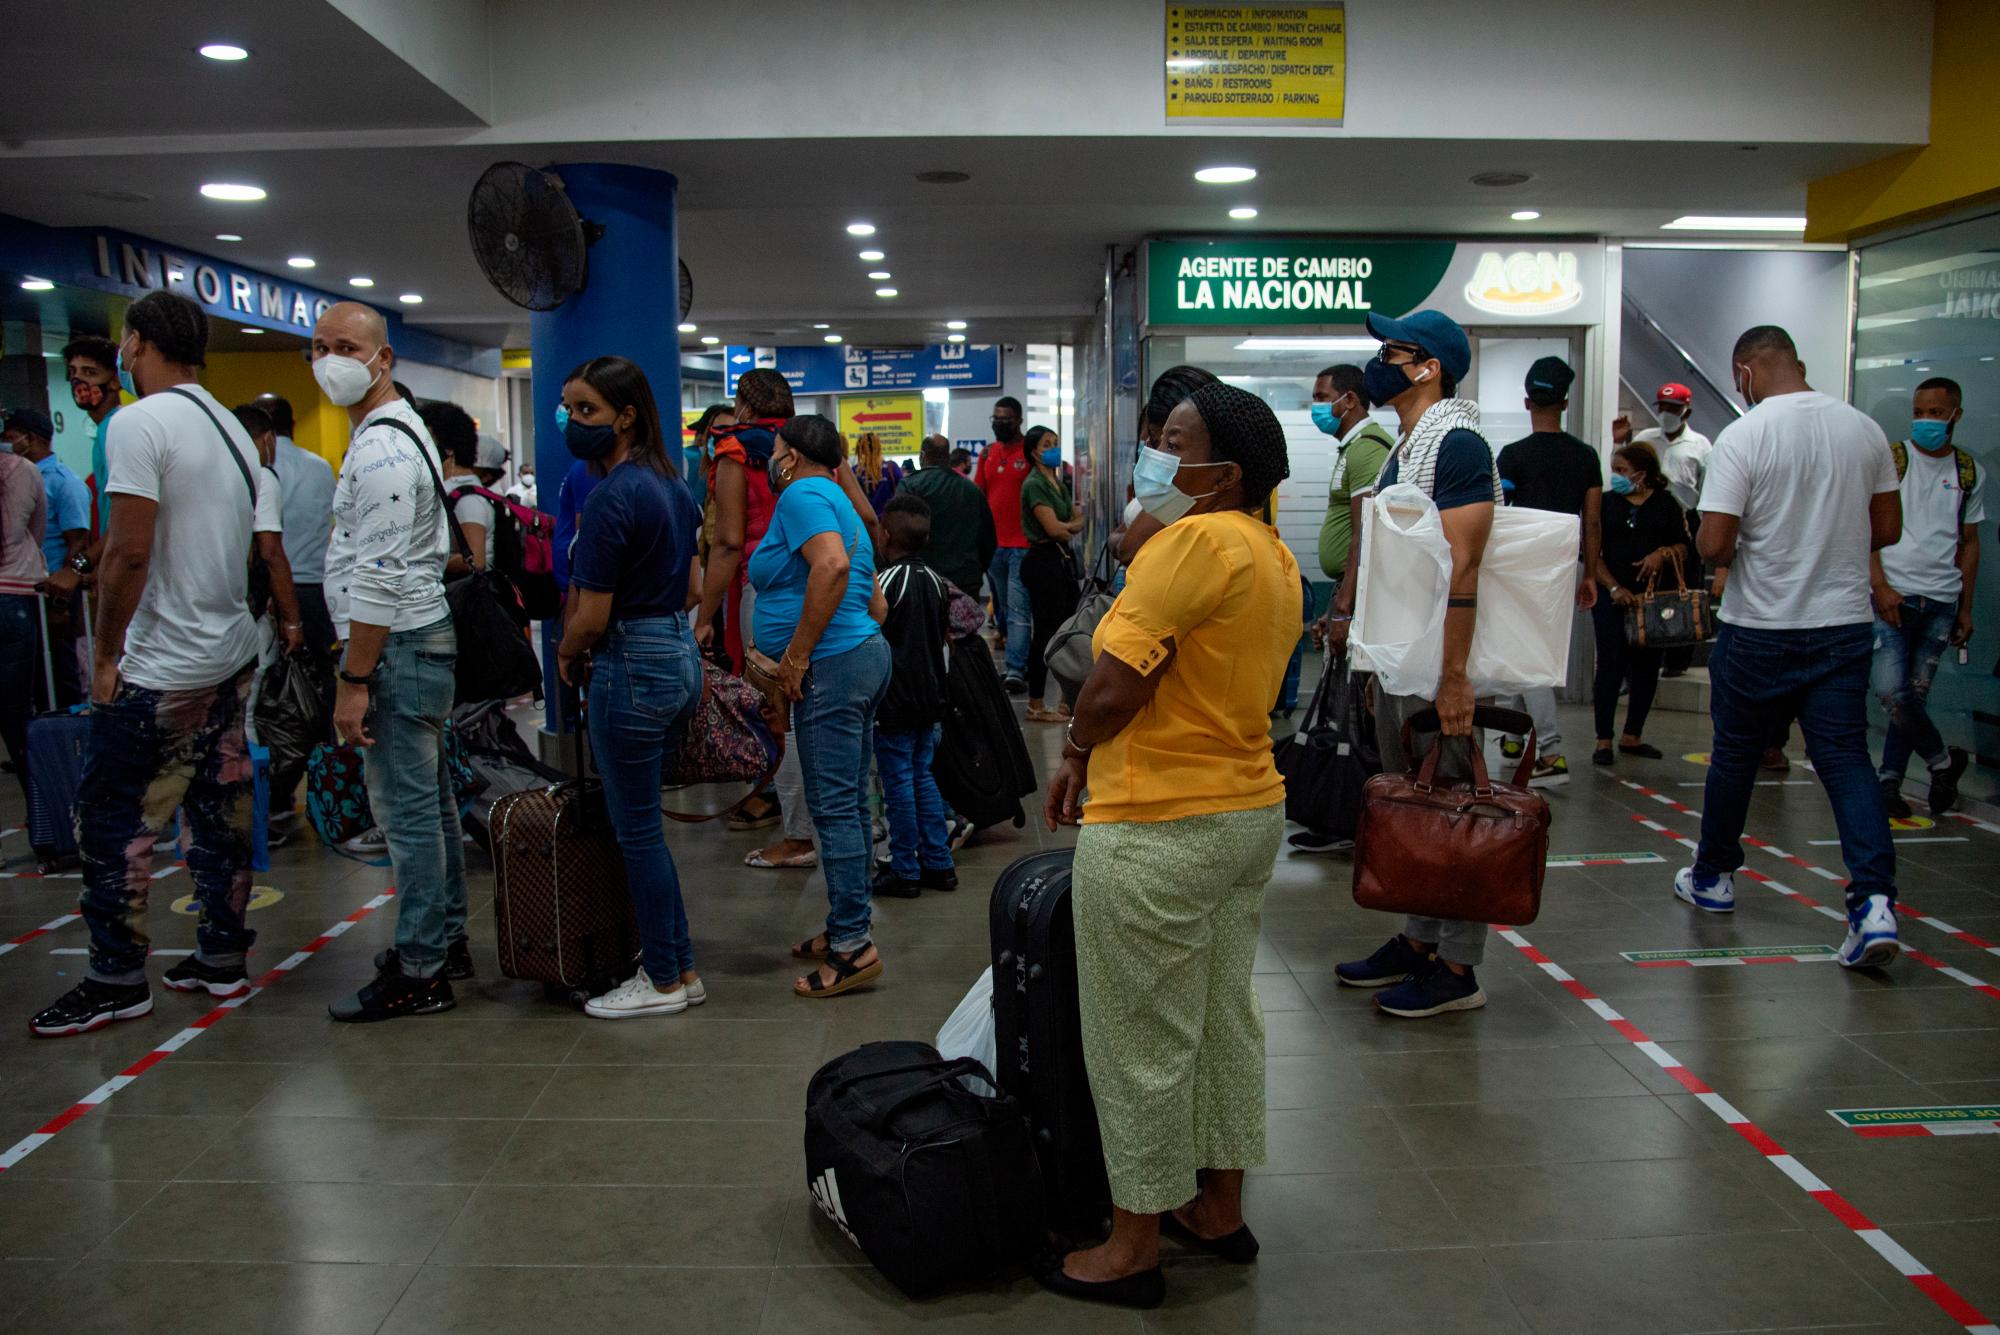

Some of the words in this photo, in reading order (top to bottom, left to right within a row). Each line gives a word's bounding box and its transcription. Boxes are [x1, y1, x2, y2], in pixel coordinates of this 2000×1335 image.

[1251, 9, 1308, 19] INFORMATION
[1185, 22, 1224, 32] ESTAFETA
[1227, 22, 1237, 32] DE
[1239, 22, 1271, 32] CAMBIO
[1277, 23, 1306, 33] MONEY
[1307, 23, 1342, 33] CHANGE
[1185, 36, 1206, 46] SALA
[1209, 36, 1219, 46] DE
[1222, 36, 1253, 46] ESPERA
[1263, 36, 1298, 46] WAITING
[1300, 36, 1323, 46] ROOM
[1185, 50, 1228, 59] ABORDAJE
[1238, 50, 1287, 60] DEPARTURE
[1209, 64, 1219, 74] DE
[1222, 64, 1265, 74] DESPACHO
[1271, 64, 1311, 75] DISPATCH
[1185, 76, 1213, 89] BAÑOS
[1223, 79, 1272, 89] RESTROOMS
[1184, 93, 1223, 104] PARQUEO
[1225, 93, 1273, 103] SOTERRADO
[1283, 93, 1319, 104] PARKING
[1178, 257, 1258, 278] AGENTE
[1262, 257, 1289, 278] DE
[1293, 257, 1372, 278] CAMBIO
[1177, 280, 1215, 309] LA
[1222, 280, 1371, 310] NACIONAL
[54, 410, 64, 433] 9
[1853, 1111, 1968, 1121] SEGURIDAD
